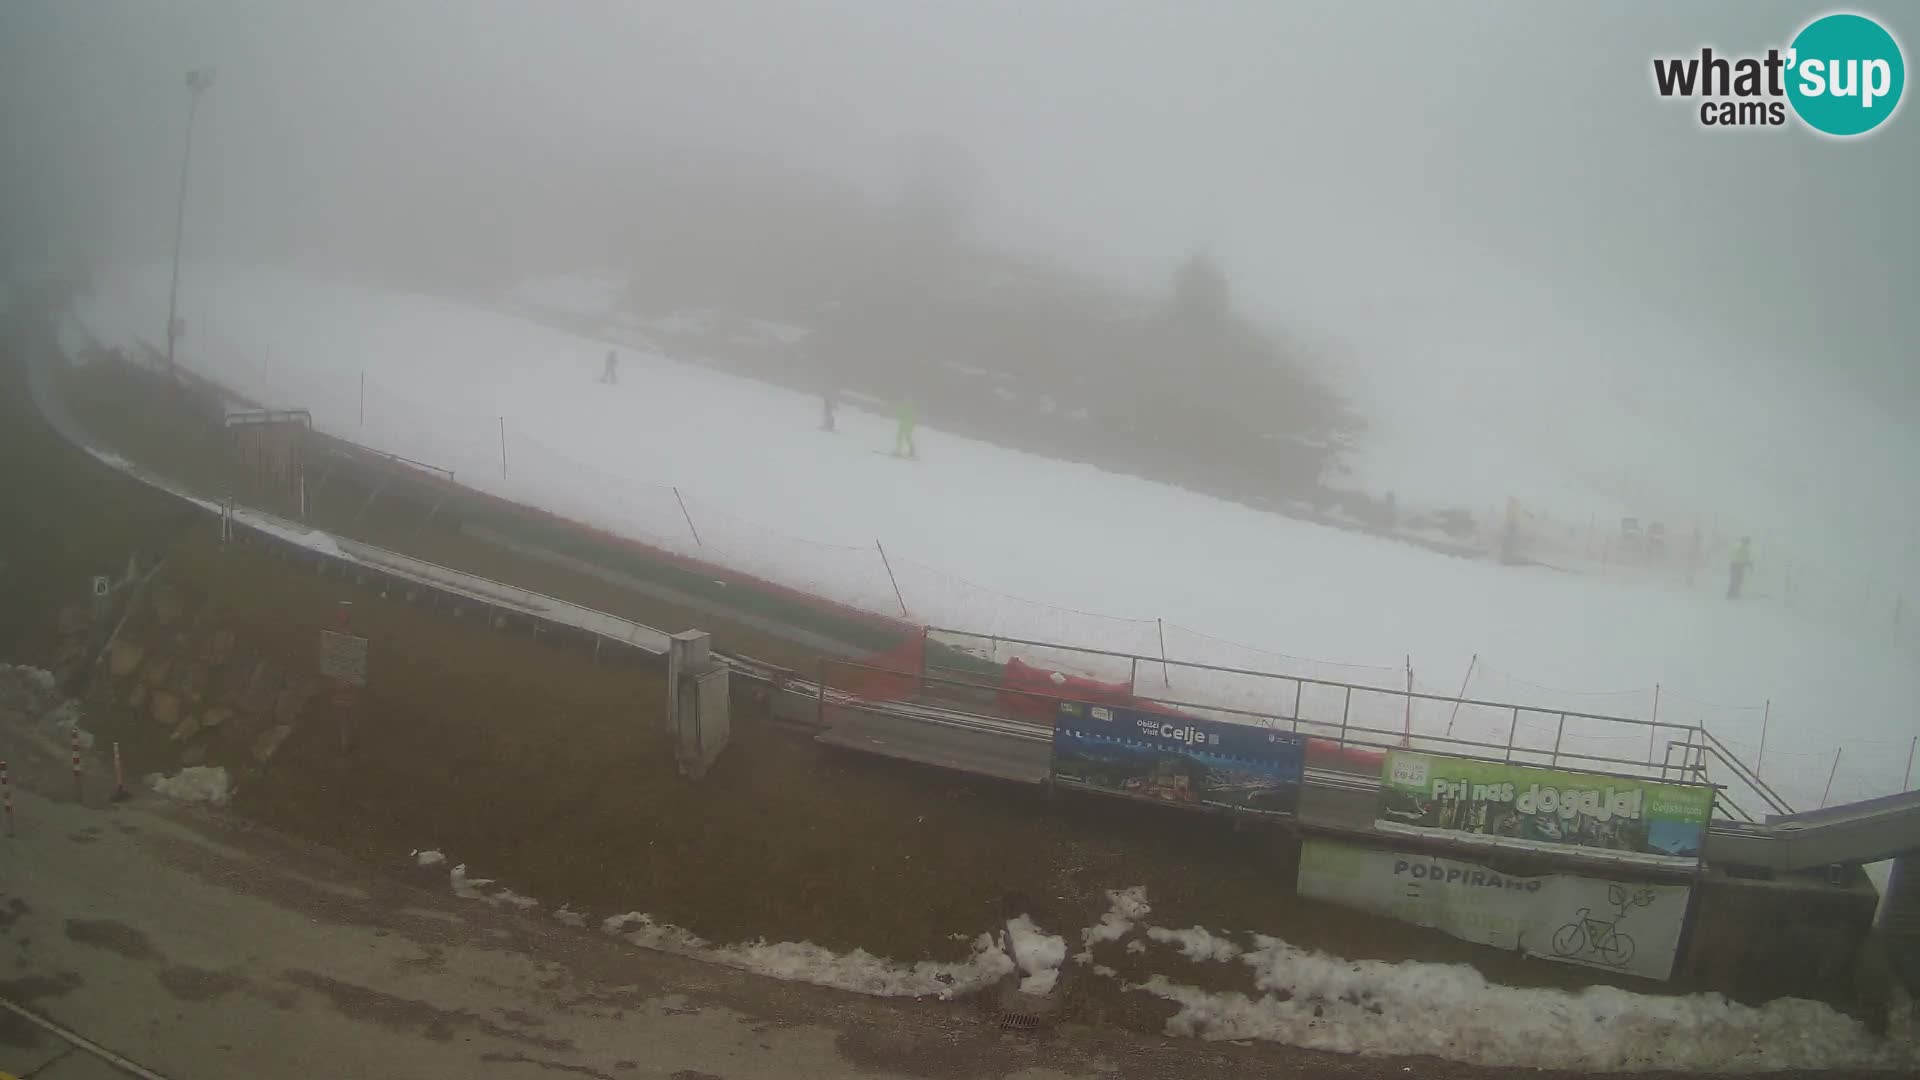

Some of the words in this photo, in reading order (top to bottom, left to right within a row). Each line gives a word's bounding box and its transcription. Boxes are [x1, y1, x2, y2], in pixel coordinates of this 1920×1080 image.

[1160, 723, 1206, 745] Celje
[1431, 778, 1468, 801] Pri
[1472, 782, 1515, 802] nas
[1516, 783, 1644, 823] dogaja!
